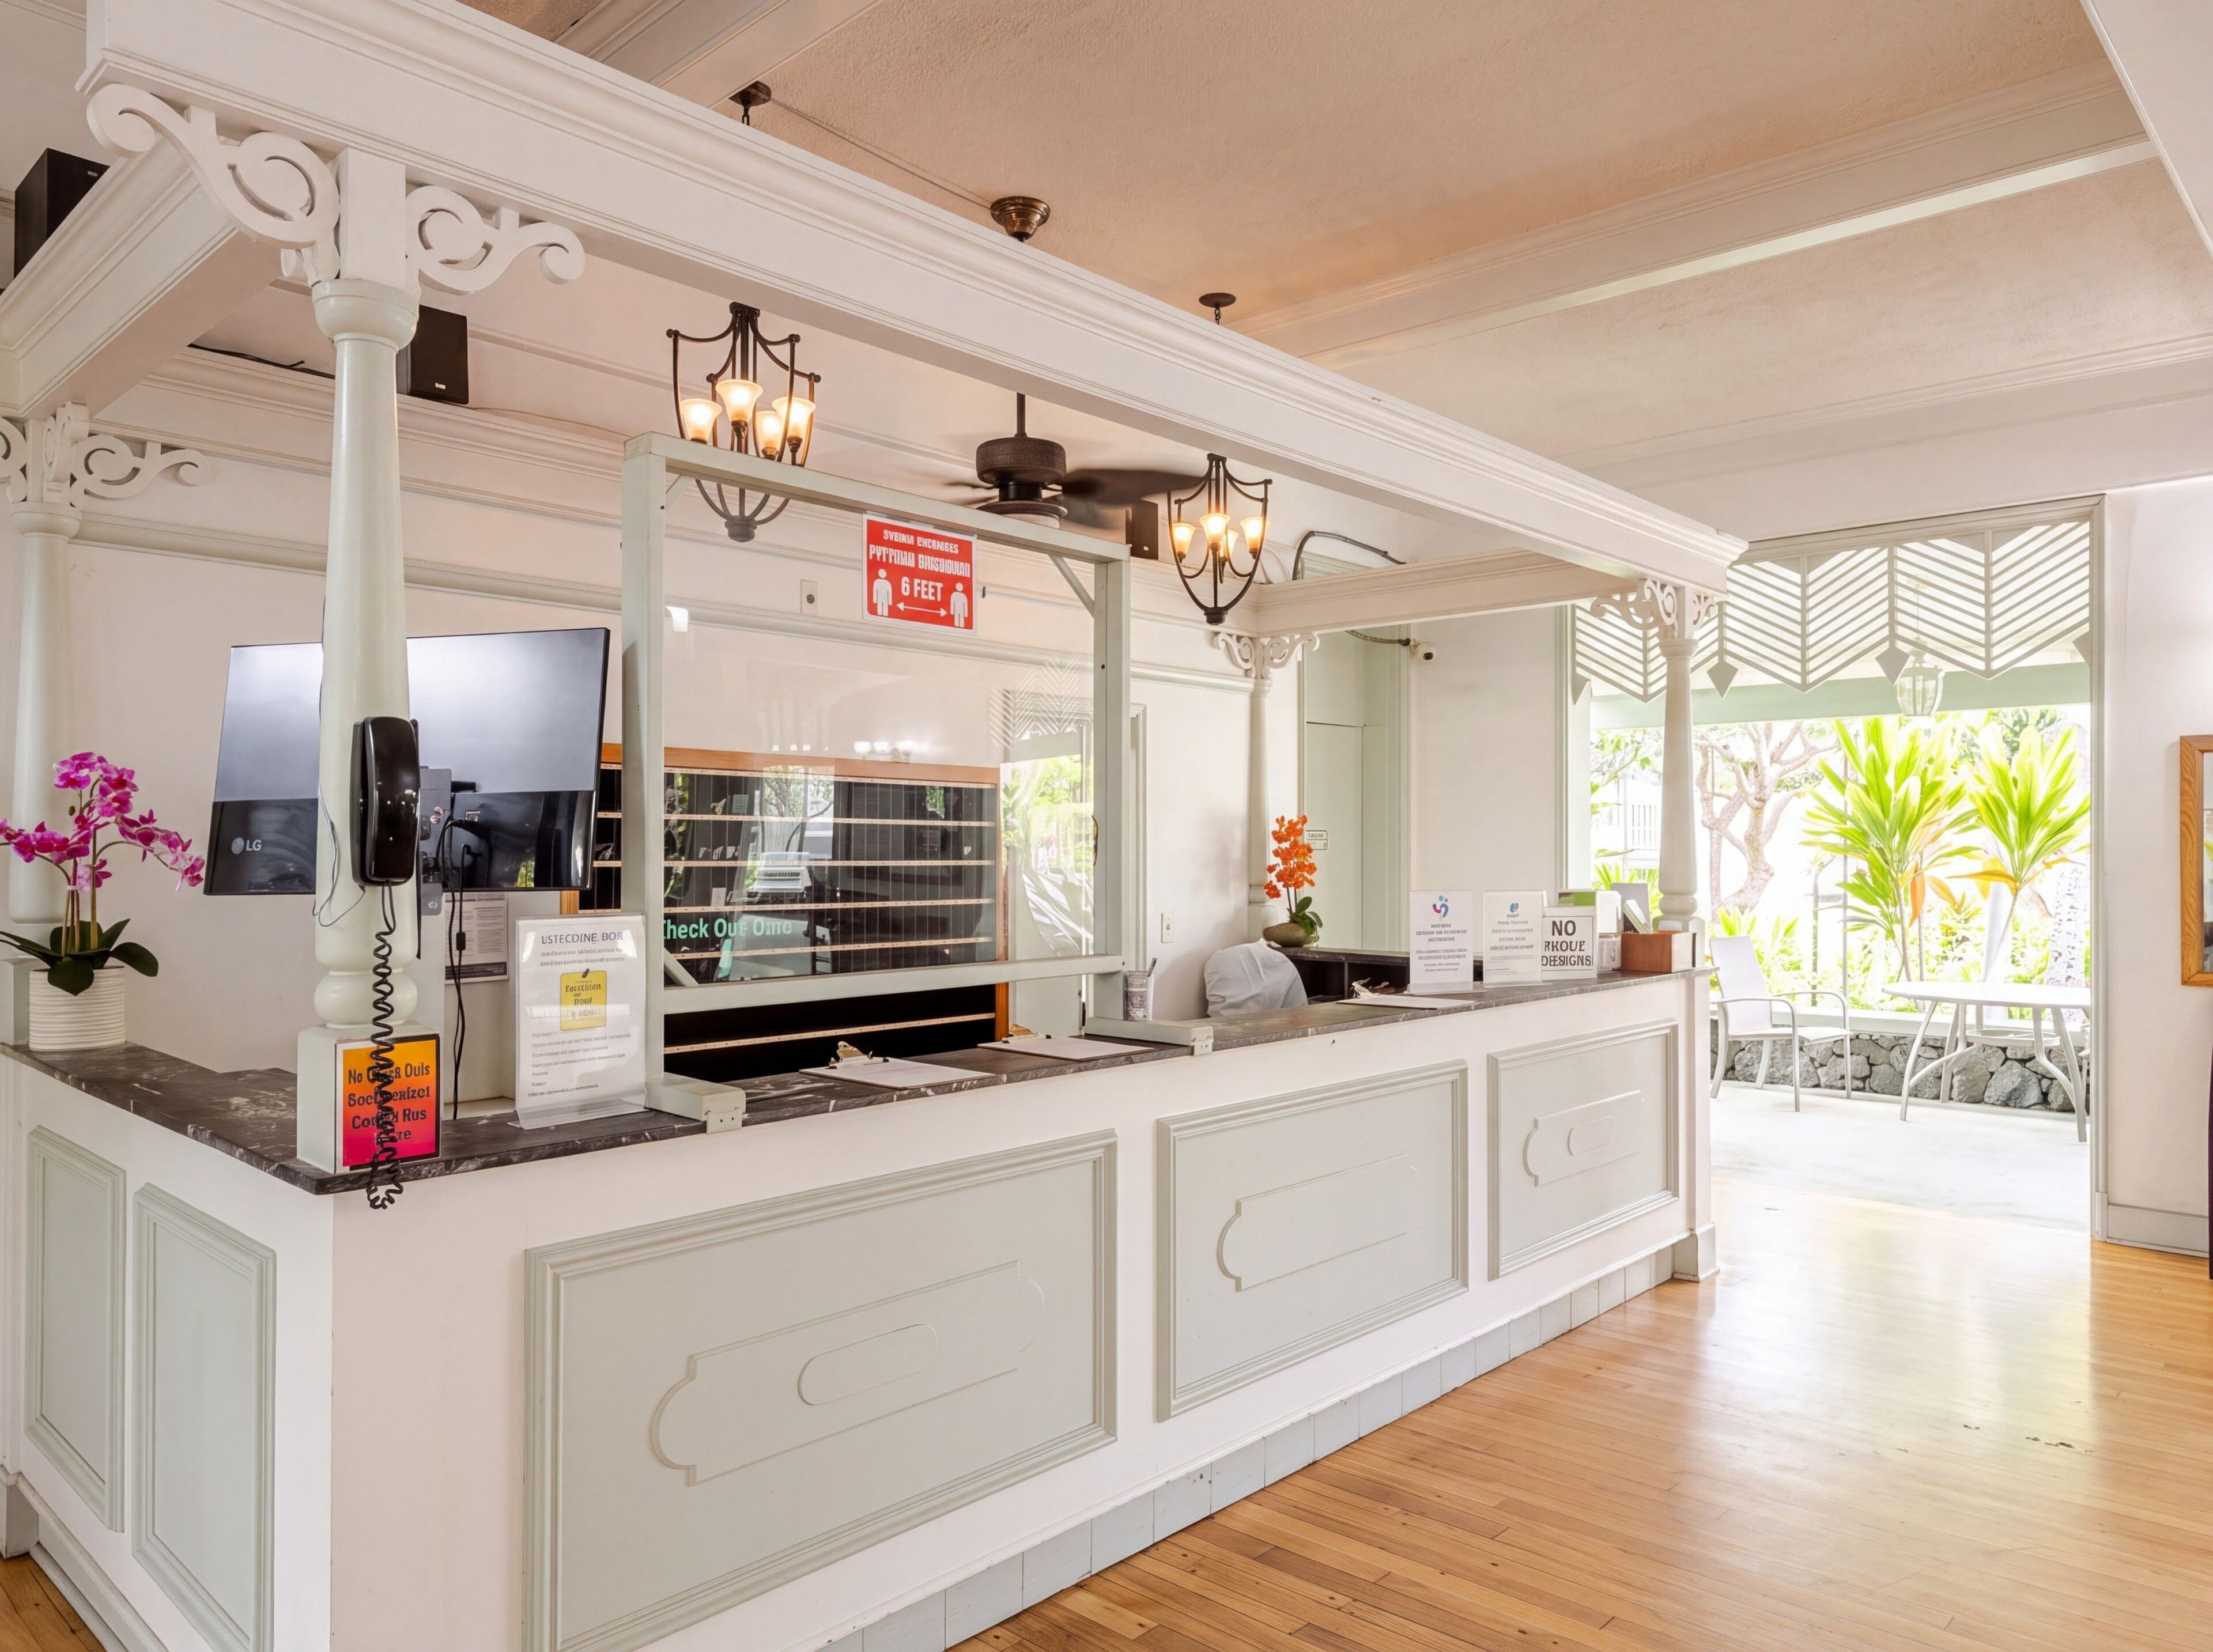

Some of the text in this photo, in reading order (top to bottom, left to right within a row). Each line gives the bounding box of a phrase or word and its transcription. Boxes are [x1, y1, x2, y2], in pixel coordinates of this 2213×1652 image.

[901, 576, 943, 602] 6 FEET
[246, 839, 262, 851] LG
[1551, 920, 1576, 936] NO
[349, 1069, 362, 1084] No
